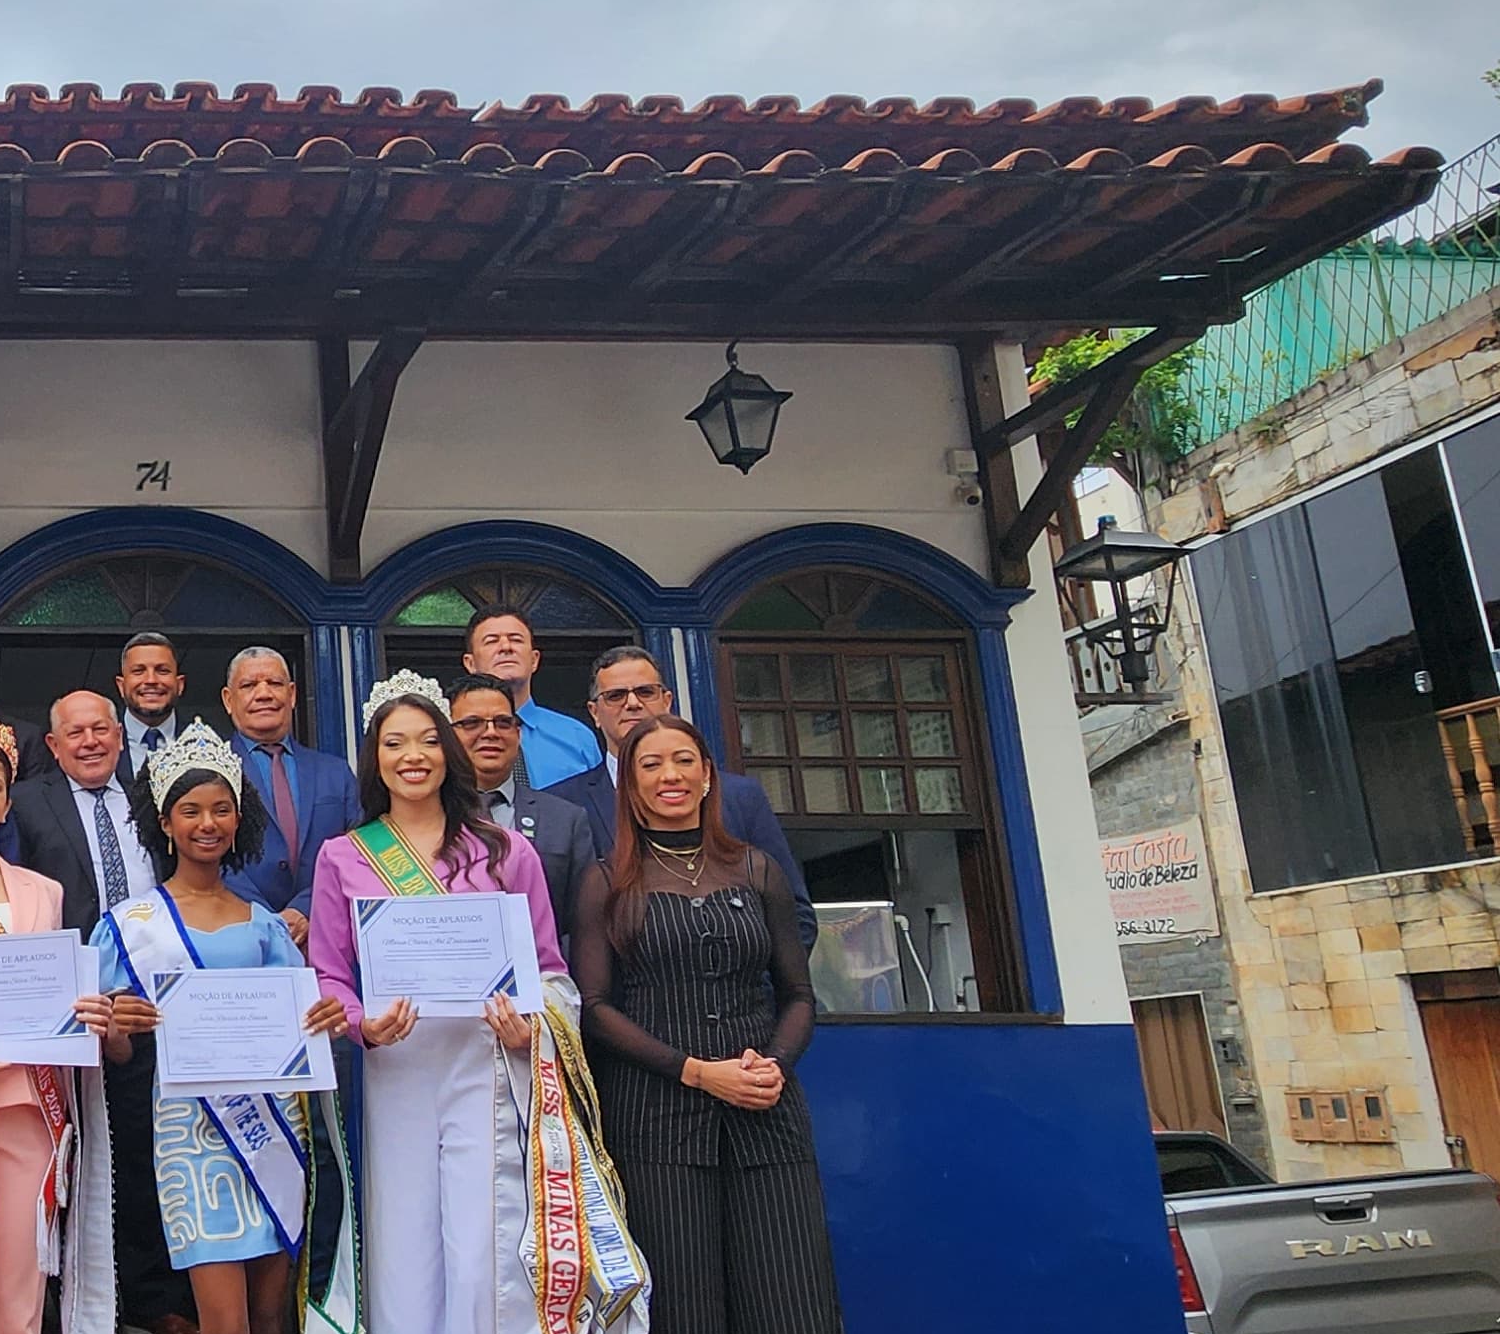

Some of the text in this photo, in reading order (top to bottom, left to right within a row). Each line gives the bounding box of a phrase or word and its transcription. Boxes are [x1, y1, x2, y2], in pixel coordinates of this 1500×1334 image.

[136, 460, 172, 491] 74
[379, 844, 413, 877] MISS
[1139, 868, 1155, 887] de
[1154, 862, 1198, 886] Beleza
[393, 915, 483, 926] MOÇÃO DE APLAUSOS
[2, 955, 13, 964] DE
[14, 953, 57, 963] APLAUSOS
[189, 991, 277, 1001] MOÇÃO DE APLAUSOS
[539, 1057, 560, 1117] MISS
[45, 1088, 64, 1127] 2025
[233, 1105, 260, 1129] THE
[243, 1122, 272, 1151] SEAS
[547, 1169, 575, 1252] MINAS
[590, 1223, 625, 1255] ZONA
[1285, 1229, 1434, 1259] RAM
[601, 1255, 631, 1273] DA
